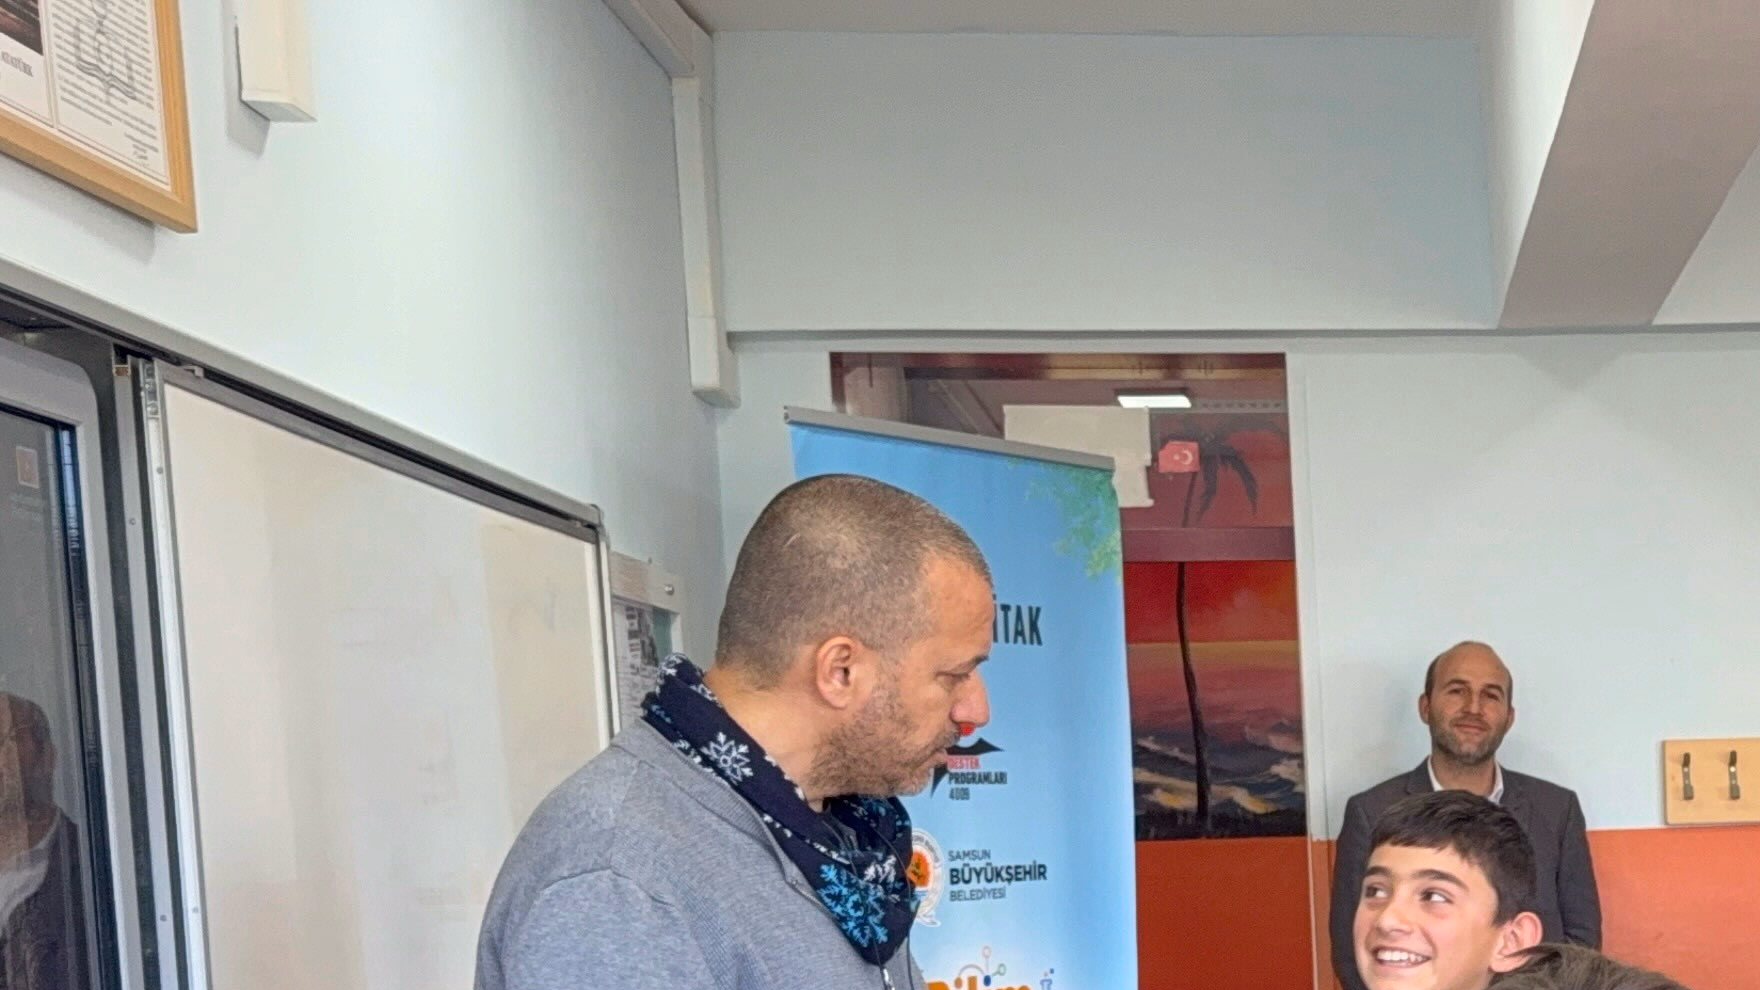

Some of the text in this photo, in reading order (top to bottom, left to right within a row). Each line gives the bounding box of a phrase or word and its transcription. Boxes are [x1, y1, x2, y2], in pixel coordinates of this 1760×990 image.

[992, 594, 1043, 647] İTAK
[949, 772, 1008, 785] PROGRAMLARI
[948, 849, 991, 862] SAMSUN
[950, 860, 1048, 886] BÜYÜKŞEHİR
[950, 887, 1007, 901] BELEDİYESİ
